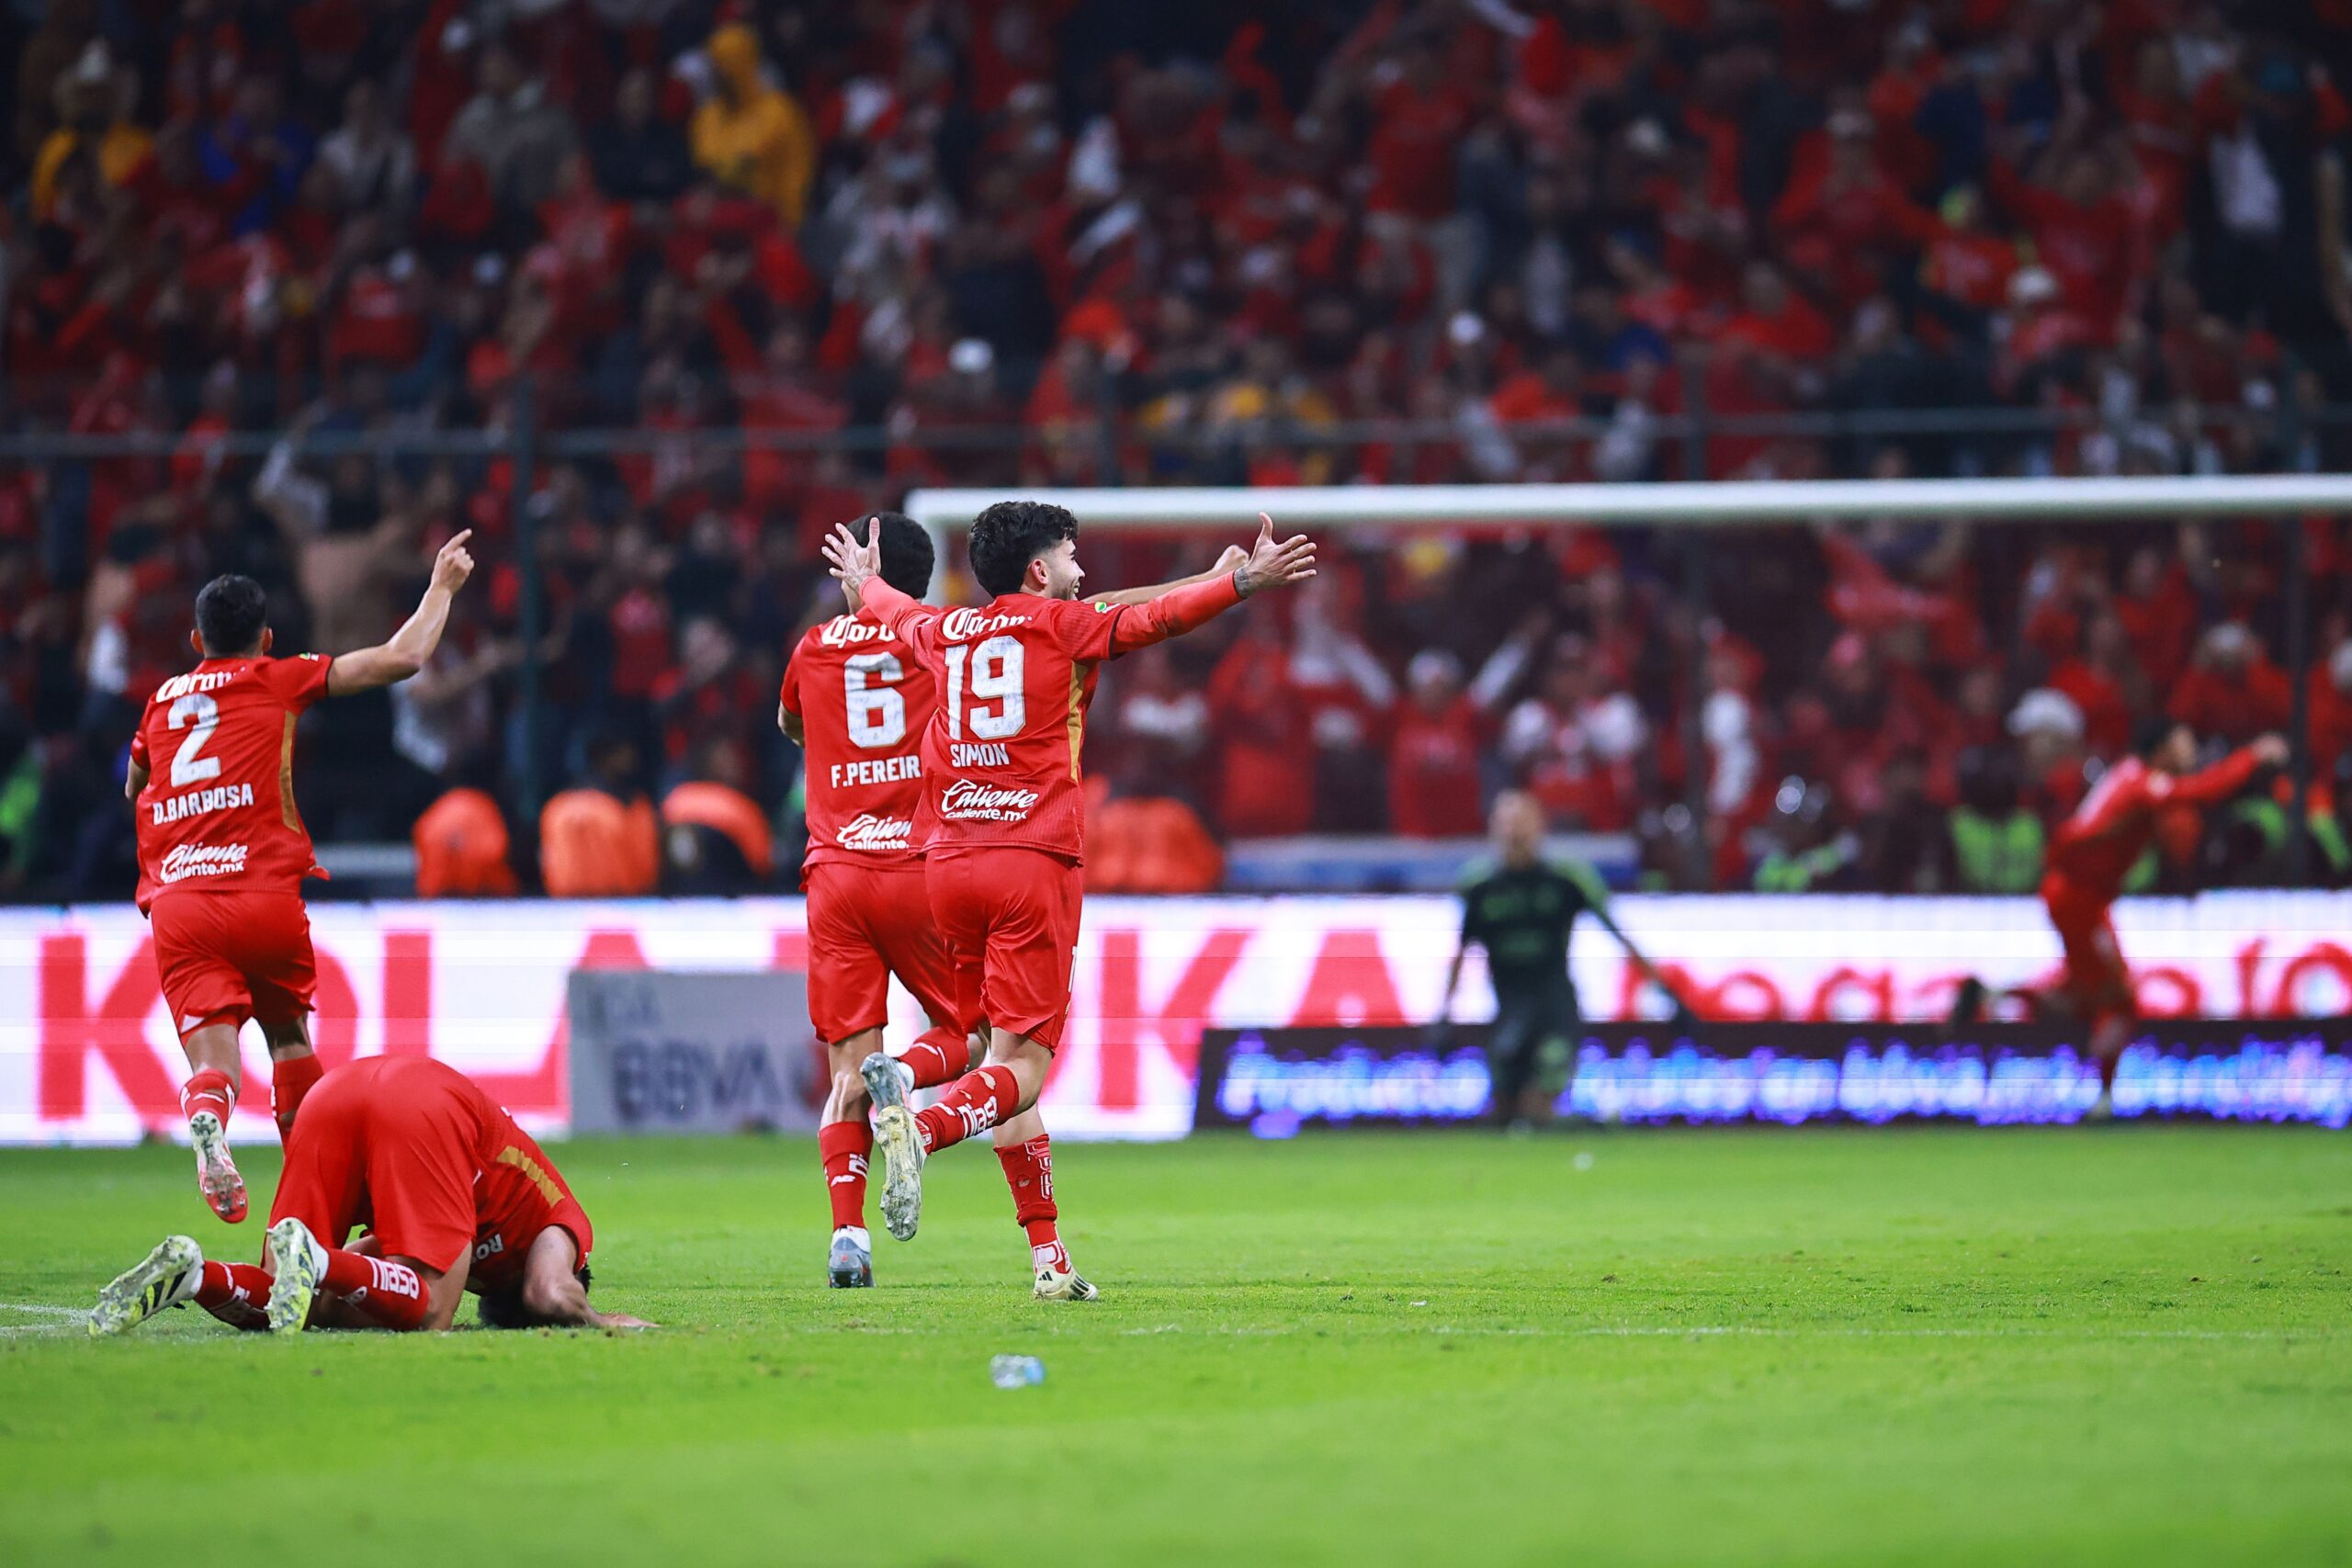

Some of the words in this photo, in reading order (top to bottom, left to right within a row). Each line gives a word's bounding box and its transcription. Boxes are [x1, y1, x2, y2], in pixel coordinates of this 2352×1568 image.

[821, 615, 897, 649] Coro
[943, 607, 1032, 641] Coron
[156, 671, 235, 704] Coron
[844, 651, 907, 750] 6
[944, 635, 1025, 741] 19
[167, 693, 221, 788] 2
[950, 743, 1010, 768] SIMON
[831, 755, 922, 788] F.PEREIR
[153, 783, 254, 826] D.BARBOSA
[942, 778, 1039, 813] Caliente
[836, 814, 912, 843] Calien
[844, 838, 910, 851] caliente.
